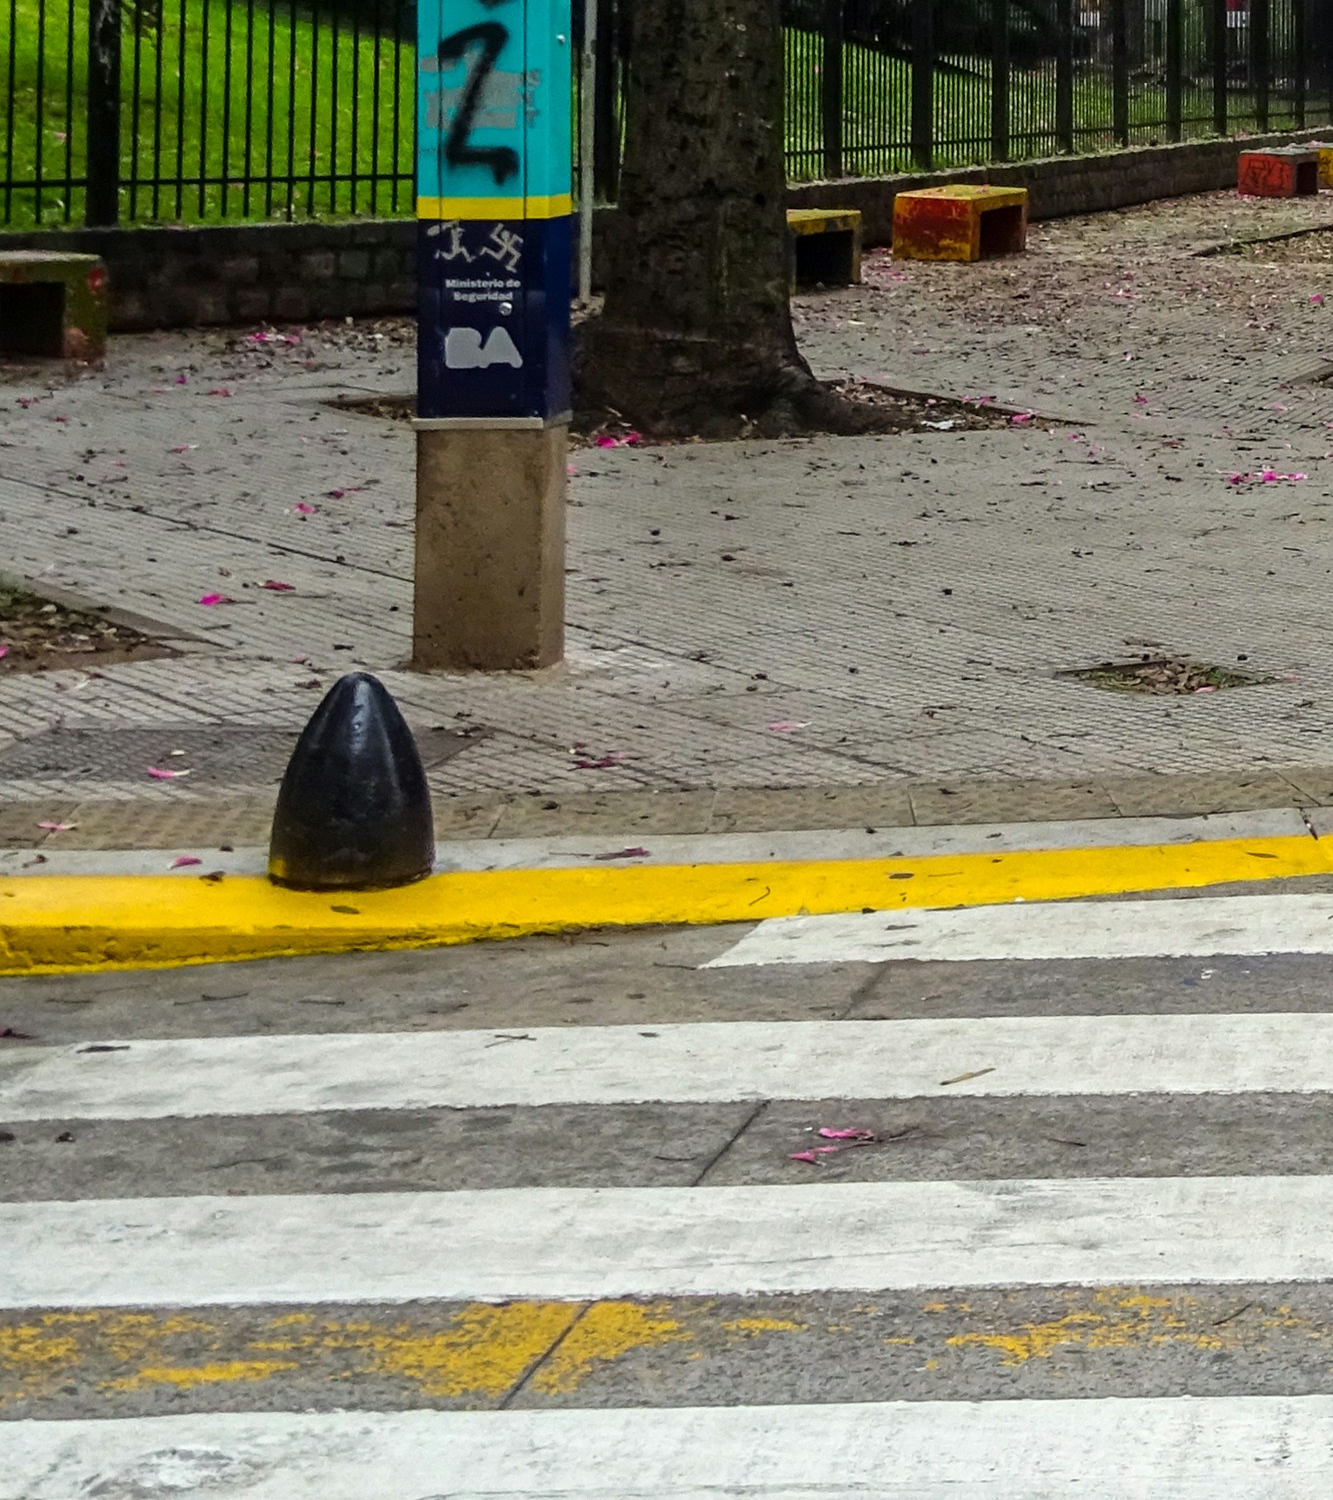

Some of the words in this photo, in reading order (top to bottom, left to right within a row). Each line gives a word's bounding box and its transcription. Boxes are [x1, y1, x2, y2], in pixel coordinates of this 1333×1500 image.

[445, 278, 504, 288] Ministerio
[506, 278, 521, 288] de
[453, 291, 513, 303] Seguridad
[444, 326, 523, 369] BA
